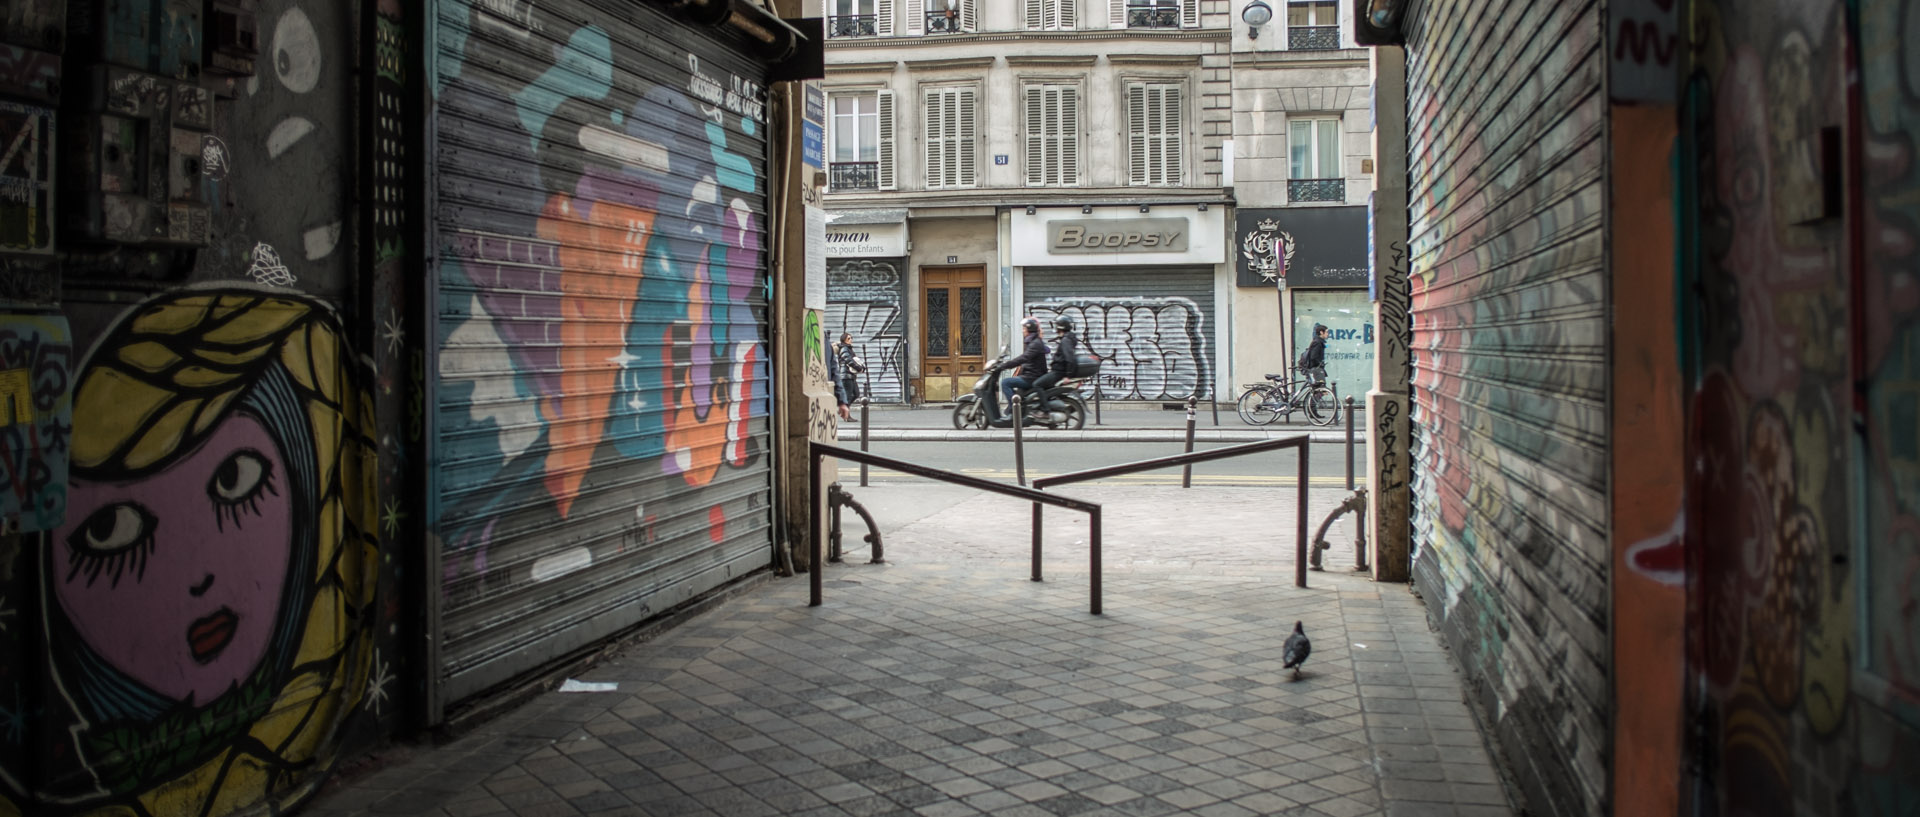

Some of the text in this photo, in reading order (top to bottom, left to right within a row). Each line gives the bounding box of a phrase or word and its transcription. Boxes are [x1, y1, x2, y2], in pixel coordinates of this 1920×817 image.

[997, 156, 1006, 164] 51
[838, 246, 856, 256] pour
[857, 244, 884, 253] Enfants
